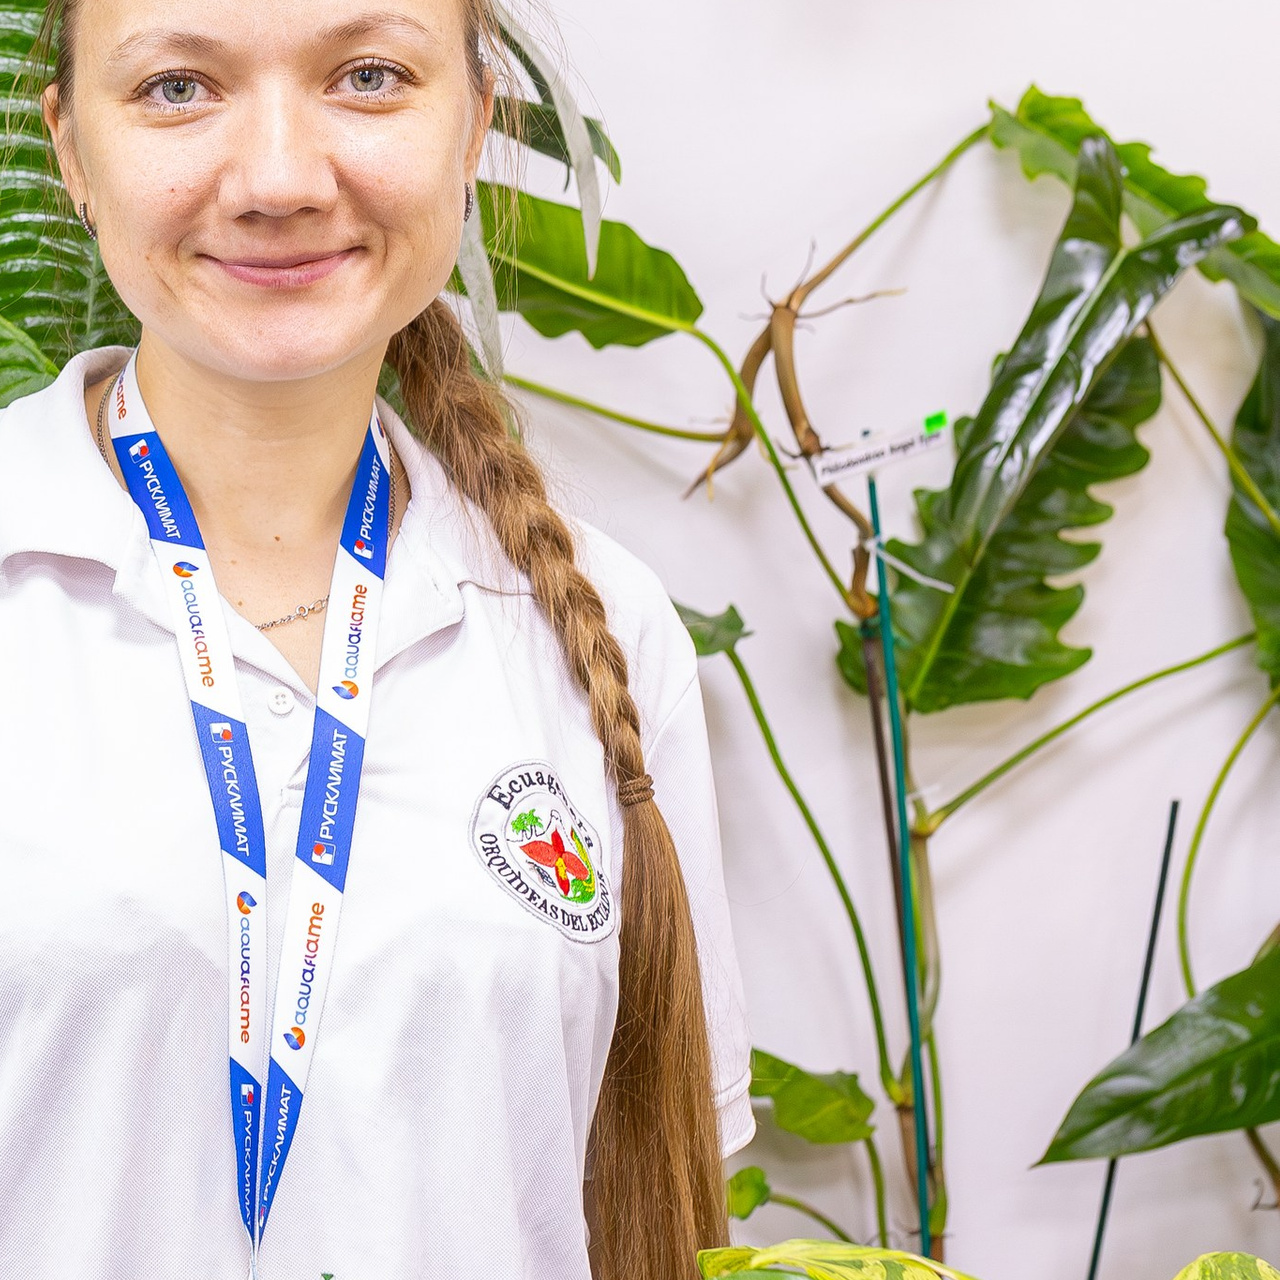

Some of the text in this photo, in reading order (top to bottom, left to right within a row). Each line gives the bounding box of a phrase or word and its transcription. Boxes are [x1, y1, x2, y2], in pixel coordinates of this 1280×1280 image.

[138, 459, 183, 541] РУСКЛИМАТ
[358, 458, 383, 542] РУСКЛИМАТ
[180, 578, 215, 689] aquaflame
[344, 583, 368, 680] aquaflame
[218, 746, 250, 858] РУСКЛИМАТ
[319, 728, 348, 840] РУСКЛИМАТ
[479, 832, 560, 921] ORQUIDEAS
[560, 908, 589, 933] DEL
[238, 915, 251, 1045] aquaflame
[294, 901, 326, 1026] aquaflame
[263, 1083, 293, 1203] РУСКЛИМАТ
